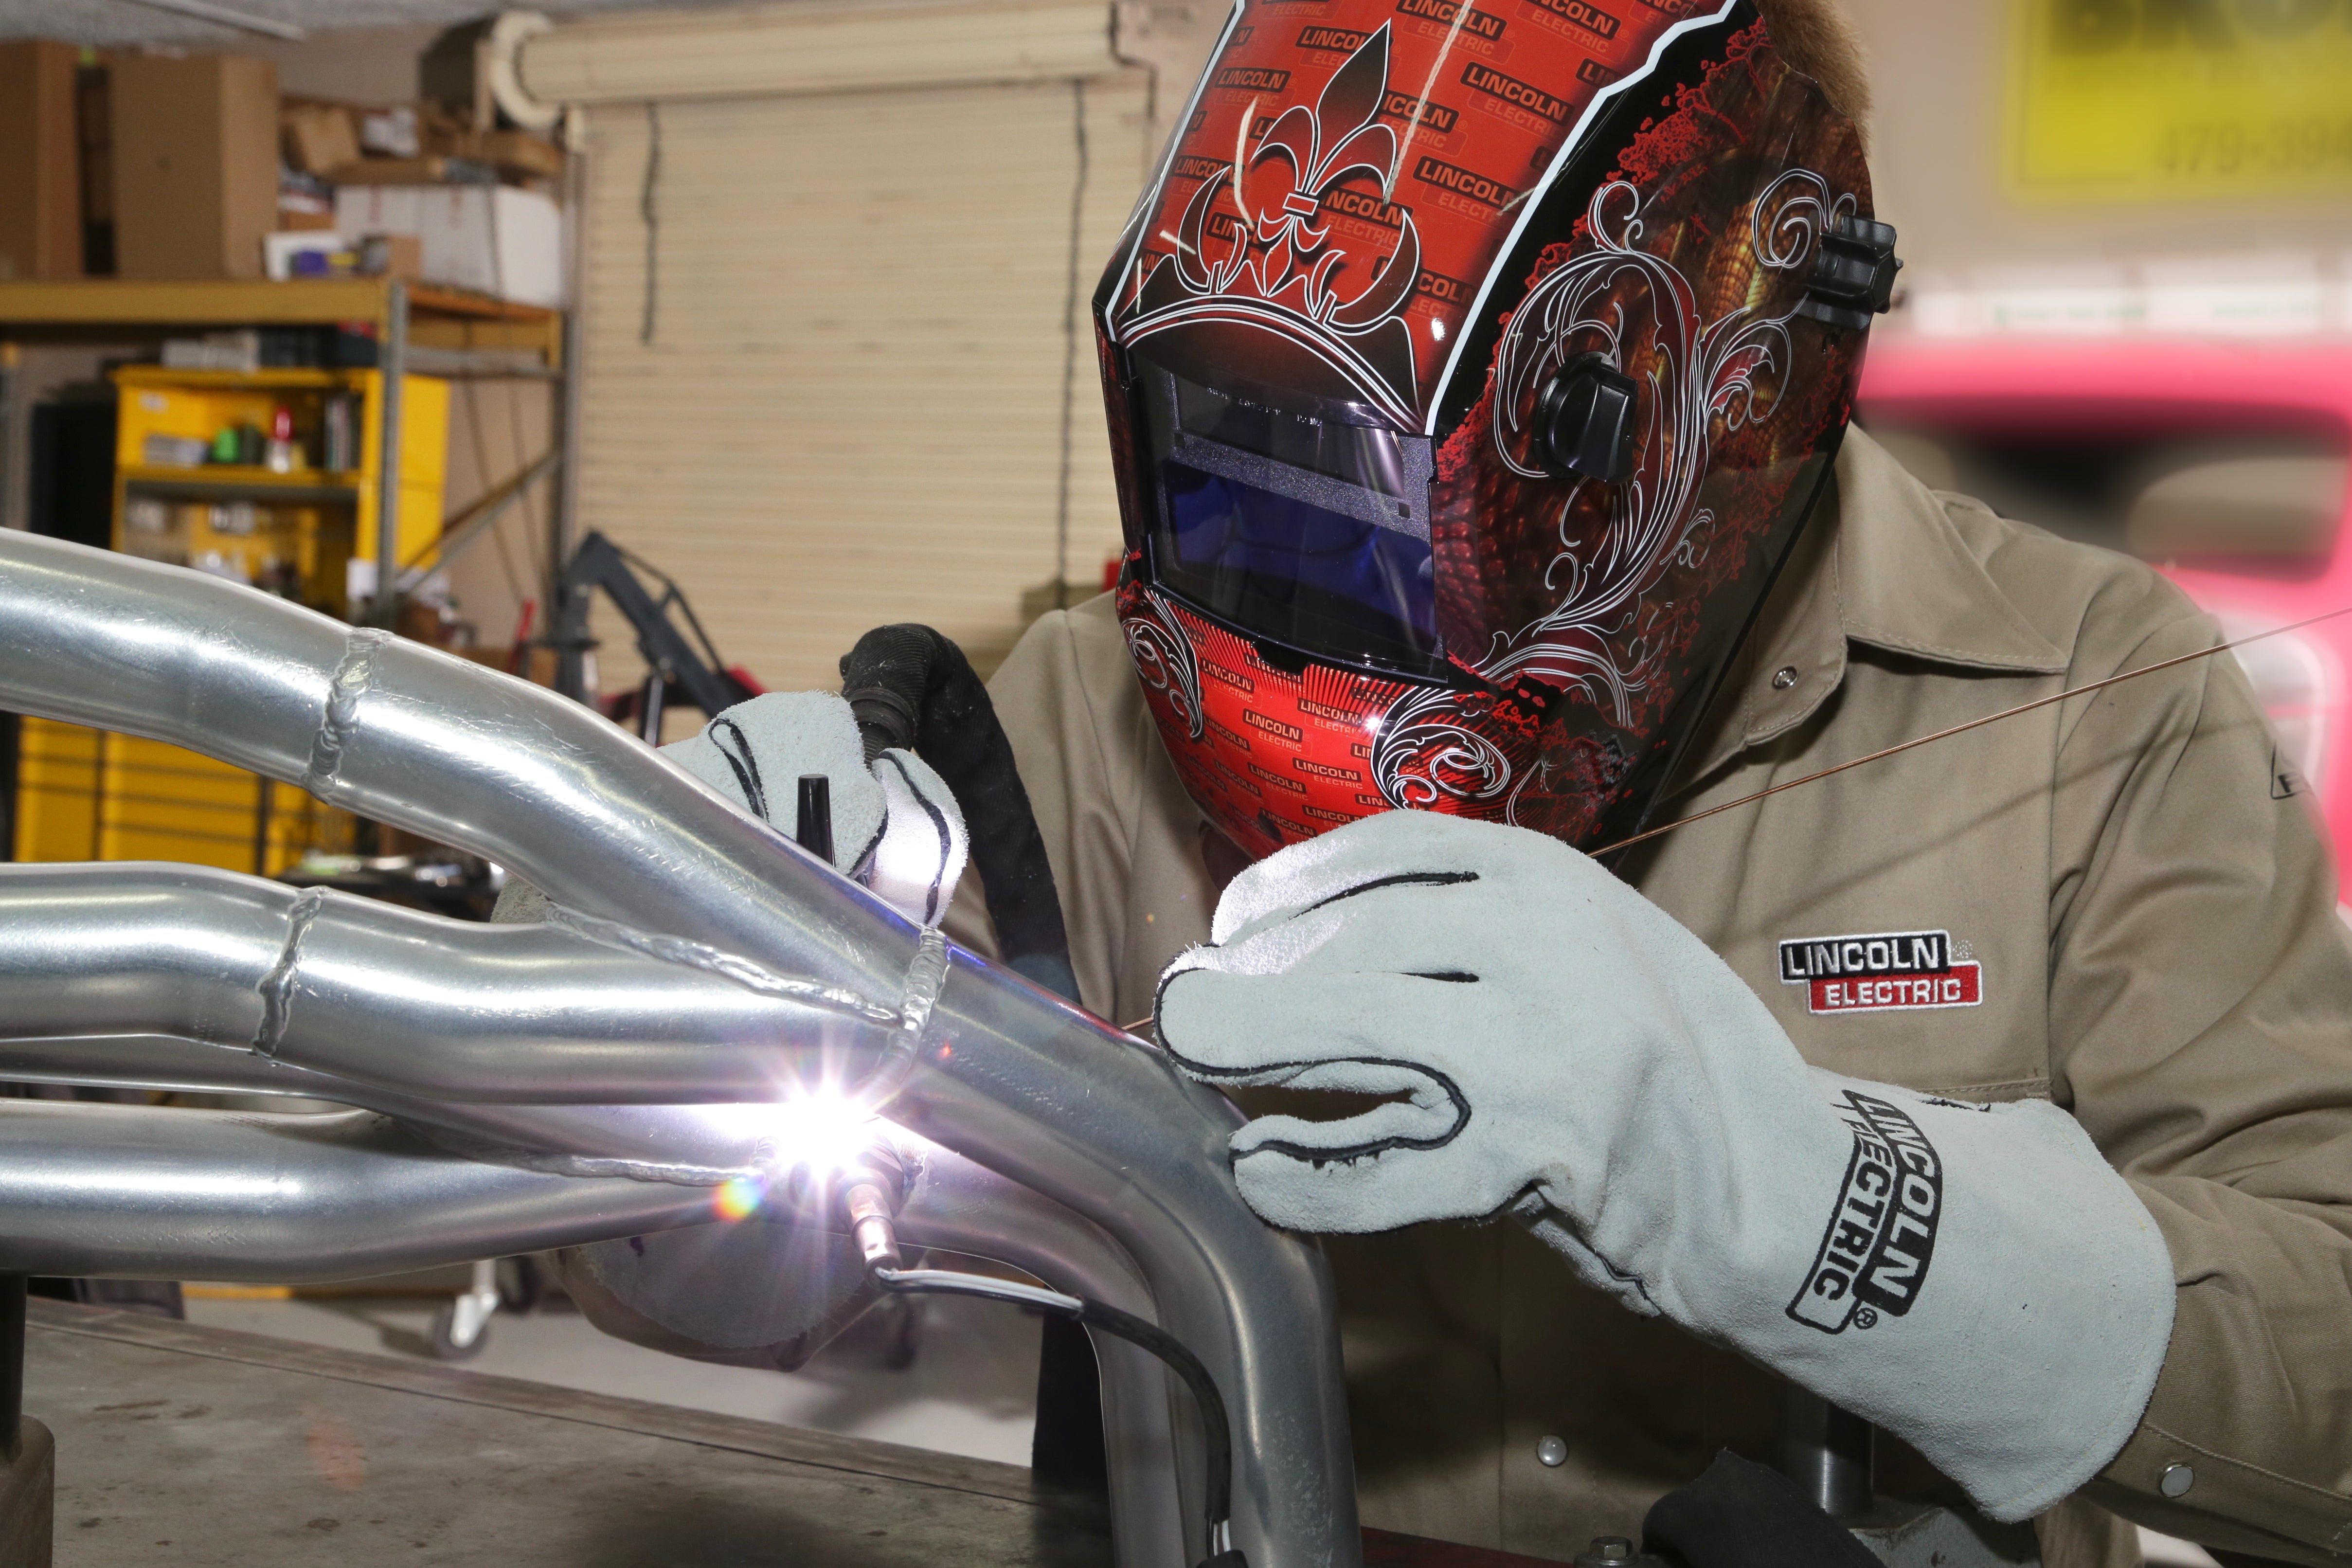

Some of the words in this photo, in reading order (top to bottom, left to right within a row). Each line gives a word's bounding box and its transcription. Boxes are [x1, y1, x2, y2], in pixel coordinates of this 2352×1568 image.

[1532, 9, 1609, 53] ELECTRIC
[1541, 0, 1614, 35] COLN
[1417, 21, 1495, 55] ELETRIC
[1219, 71, 1286, 89] LINCOLN
[1467, 67, 1568, 121] LINCOLN
[1322, 190, 1402, 226] NCOLN
[1203, 715, 1248, 749] LINCOLN
[1245, 711, 1300, 740] LINCOLN
[1258, 731, 1302, 752] ELECTRIC
[1216, 761, 1259, 795] LINCOLN
[1251, 764, 1303, 792] LINCOLN
[1296, 760, 1358, 781] LINCOLN
[1313, 776, 1364, 791] ELECTRIC
[1266, 782, 1309, 801] ELECTRIC
[1786, 937, 1939, 976] LINCOLN
[1825, 978, 1961, 1007] ELECTRIC
[1855, 1099, 1936, 1298] LINCOLN
